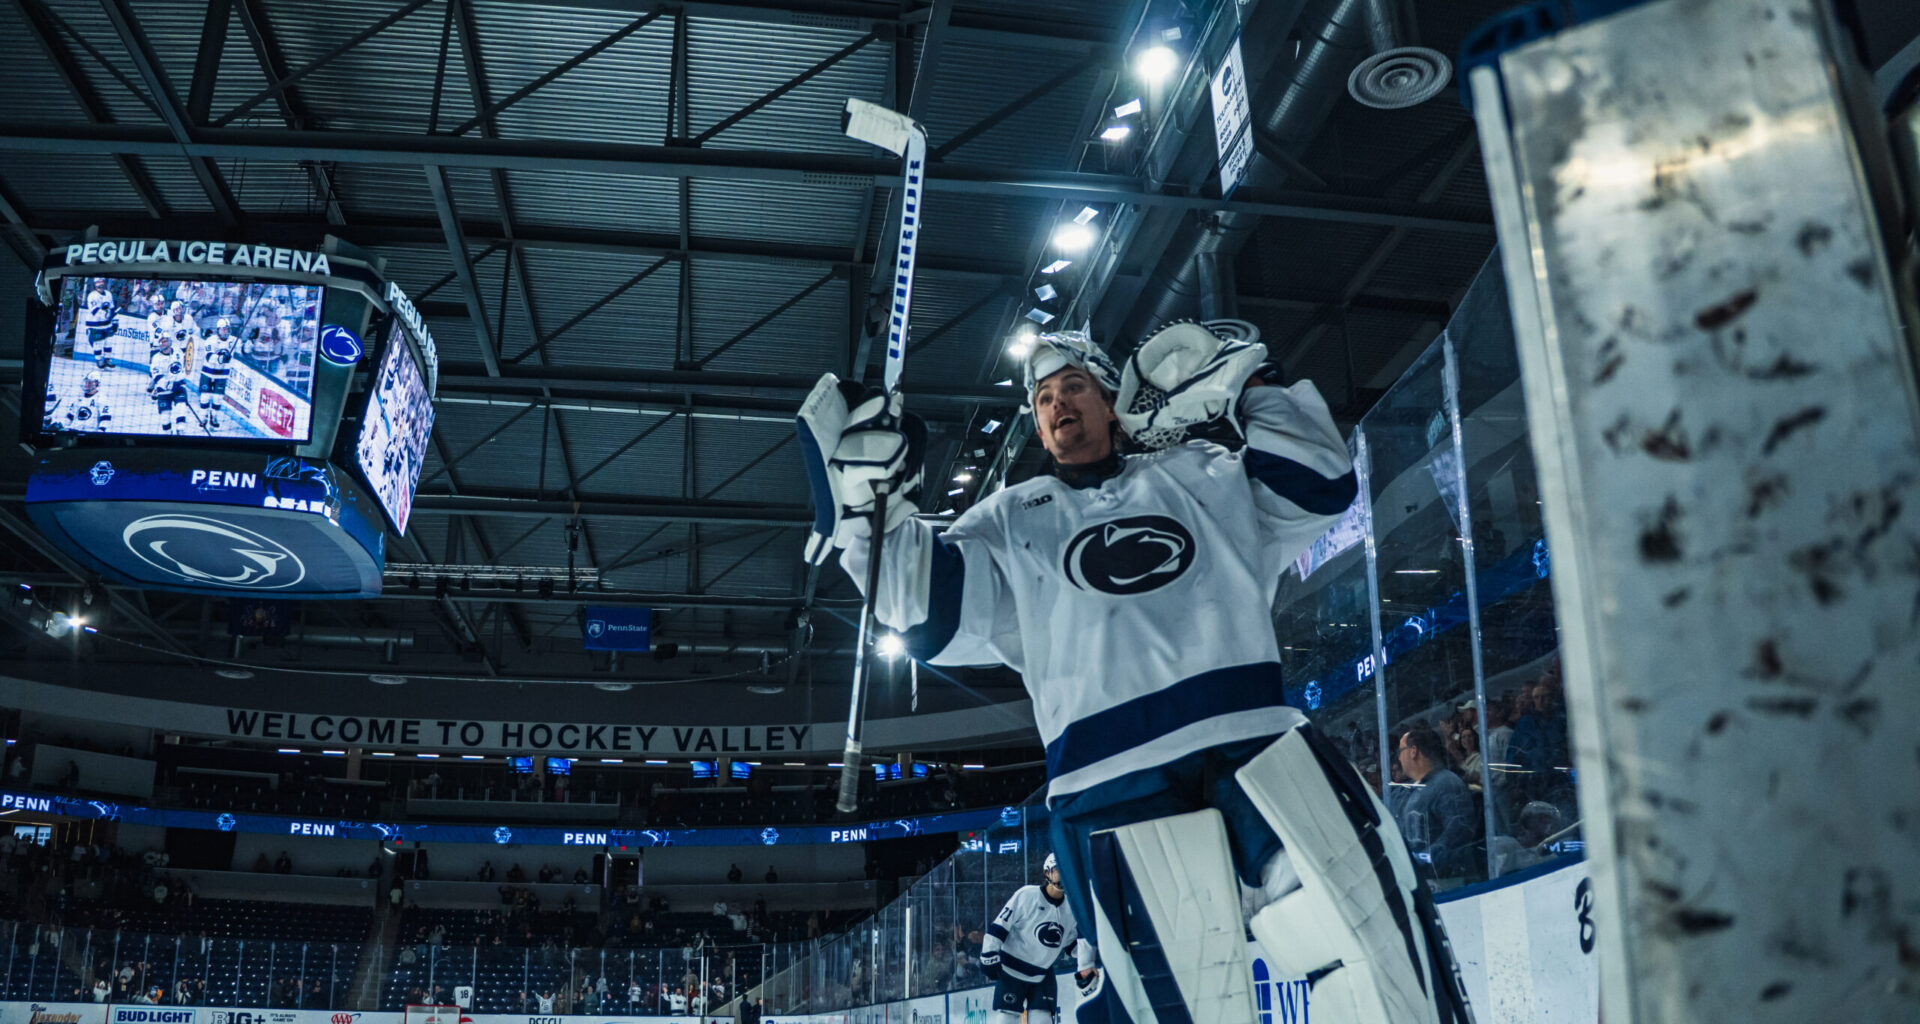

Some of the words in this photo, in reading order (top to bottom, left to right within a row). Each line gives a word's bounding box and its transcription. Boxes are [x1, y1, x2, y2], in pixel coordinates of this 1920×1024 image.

[65, 240, 172, 265] PEGULA
[178, 241, 226, 264] ICE
[231, 244, 331, 276] ARENA
[260, 393, 293, 432] SHEETZ
[191, 469, 257, 488] PENN
[607, 624, 648, 632] PennState
[226, 709, 421, 744] WELCOME
[437, 721, 485, 747] TO
[501, 723, 658, 750] HOCKEY
[673, 725, 810, 751] VALLEY
[2, 794, 50, 811] PENN
[290, 822, 335, 836] PENN
[831, 829, 867, 842] PENN
[563, 833, 607, 845] PENN
[1000, 907, 1013, 922] 71
[460, 989, 469, 998] 18
[117, 1010, 148, 1022] BUD
[148, 1011, 193, 1023] LIGHT
[332, 1014, 351, 1024] AAA
